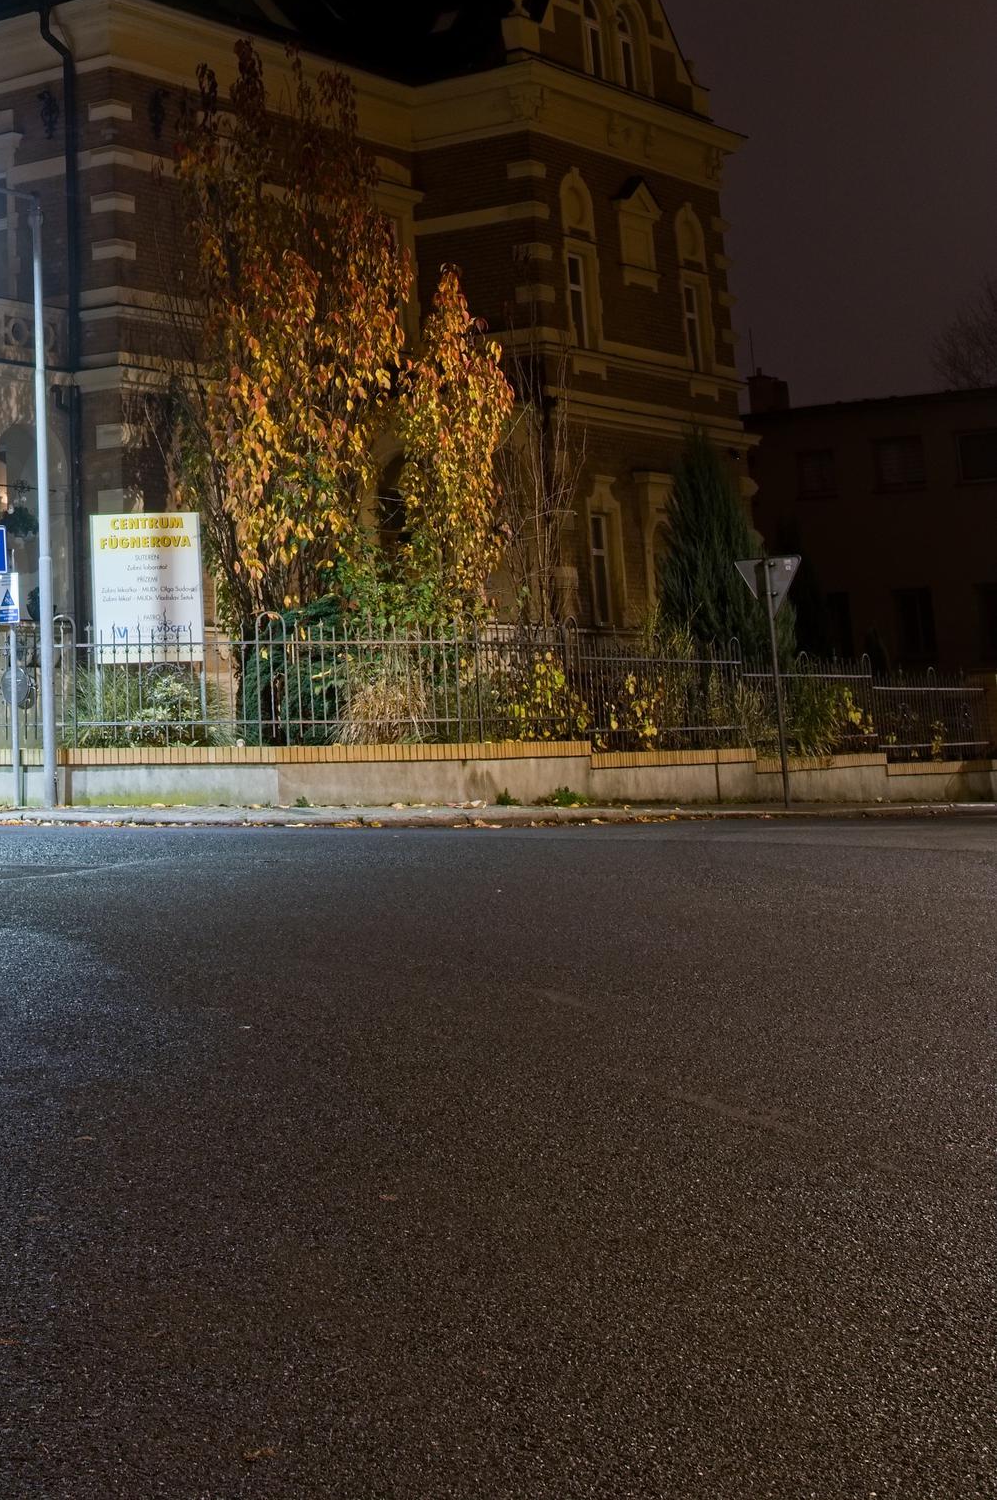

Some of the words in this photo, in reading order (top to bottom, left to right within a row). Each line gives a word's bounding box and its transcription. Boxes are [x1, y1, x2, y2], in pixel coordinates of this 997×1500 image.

[110, 516, 184, 530] CENTRUM
[99, 534, 191, 549] FÜGNEROVA
[160, 585, 174, 593] Olga
[156, 625, 188, 633] VOGEL
